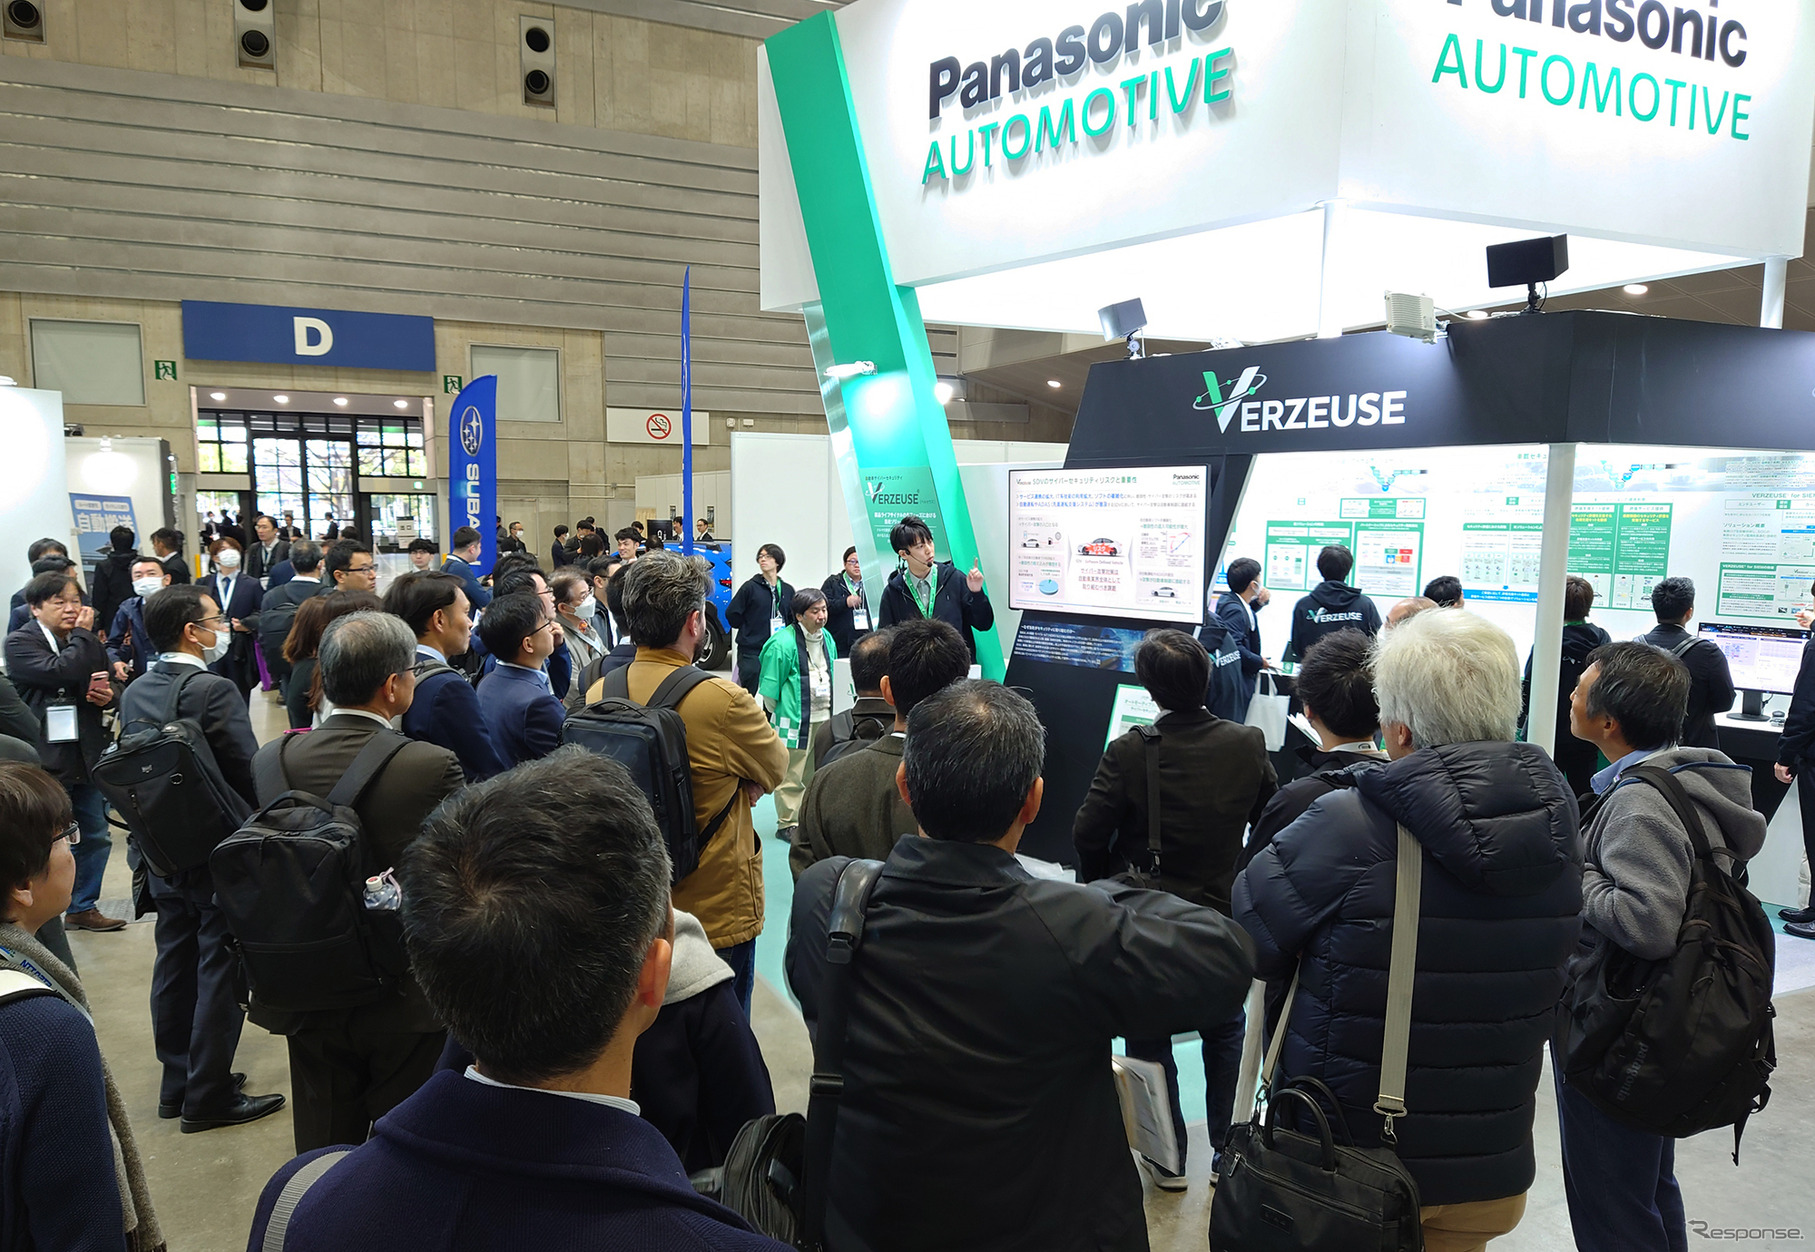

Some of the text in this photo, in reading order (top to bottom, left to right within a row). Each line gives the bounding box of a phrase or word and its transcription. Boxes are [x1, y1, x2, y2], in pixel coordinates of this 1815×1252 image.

[929, 0, 1222, 120] Panasonic
[1431, 33, 1752, 141] AUTOMOTIVE
[921, 46, 1233, 185] AUTOMOTIVE
[293, 316, 334, 356] D
[1193, 365, 1407, 434] VERZEUSE
[1306, 606, 1363, 624] VERZEUSE
[1617, 1040, 1650, 1102] patagonia
